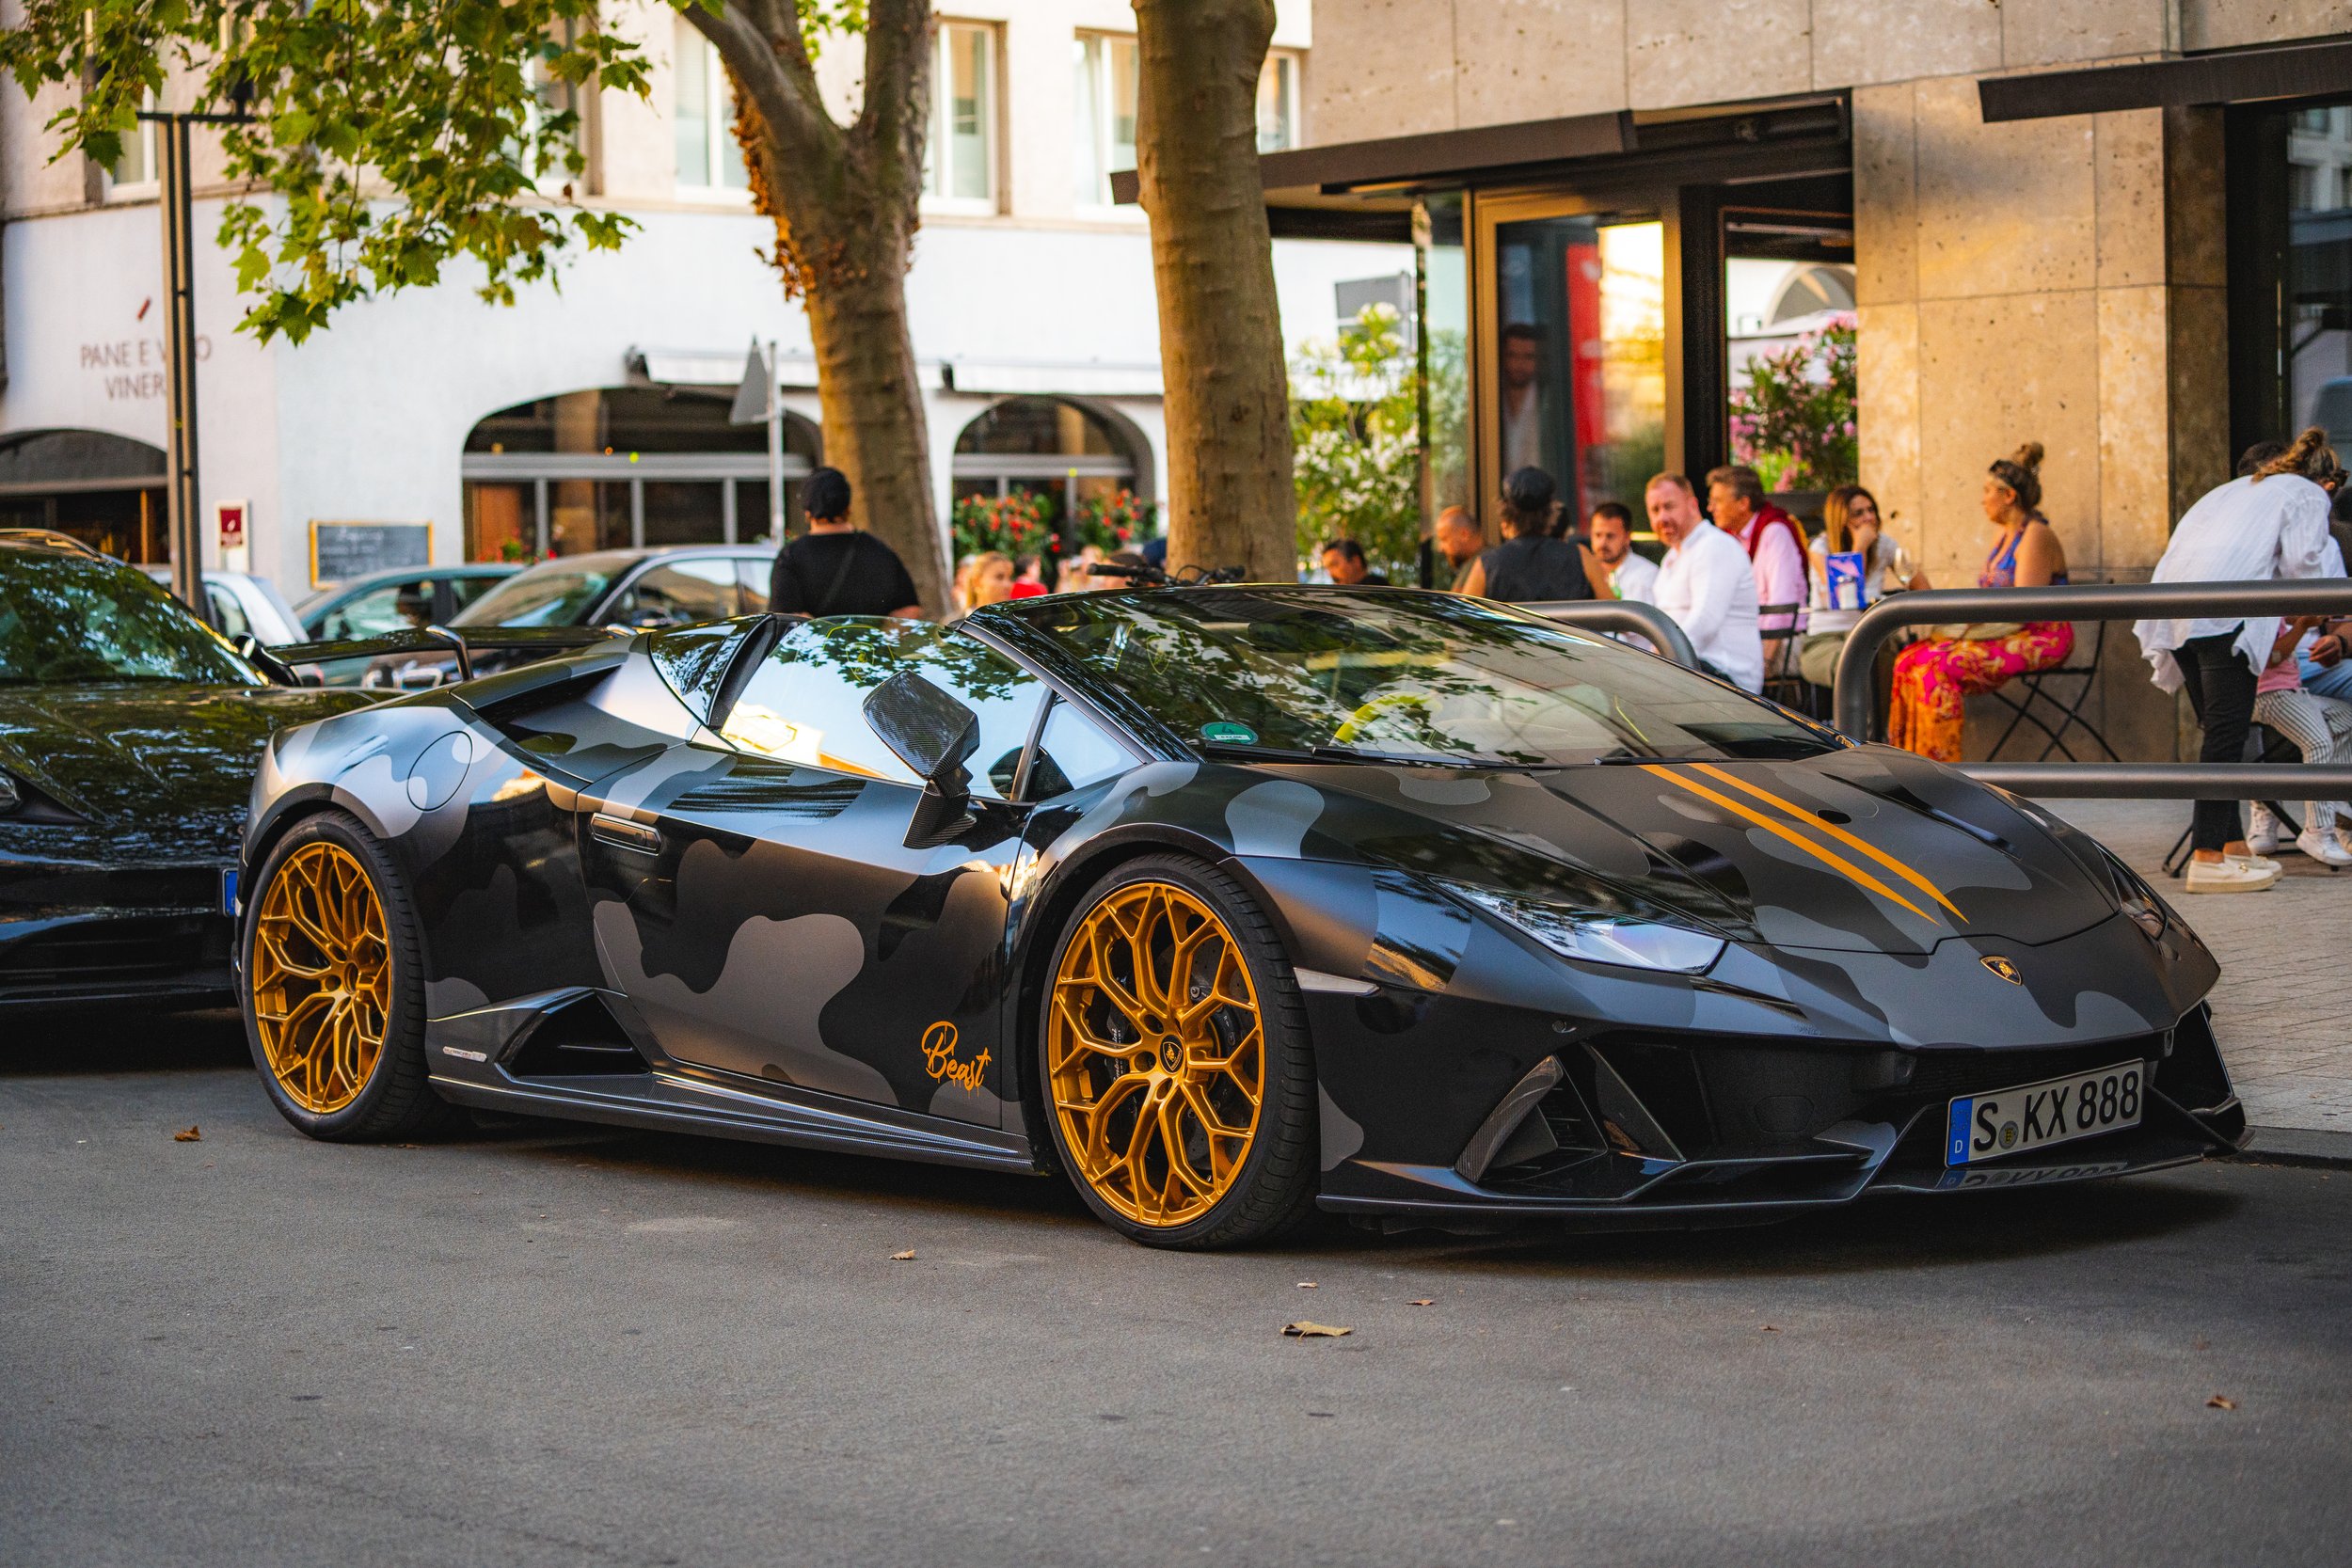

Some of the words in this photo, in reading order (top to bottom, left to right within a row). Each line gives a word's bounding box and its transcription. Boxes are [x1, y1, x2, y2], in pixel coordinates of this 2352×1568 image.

[80, 341, 130, 368] PANE
[138, 339, 150, 366] E
[156, 334, 213, 362] VO
[104, 372, 167, 400] VINER
[921, 1021, 992, 1093] Beast
[1973, 1101, 1998, 1152] S
[2022, 1085, 2070, 1143] KX
[2076, 1069, 2139, 1130] 888
[1954, 1139, 1963, 1154] D
